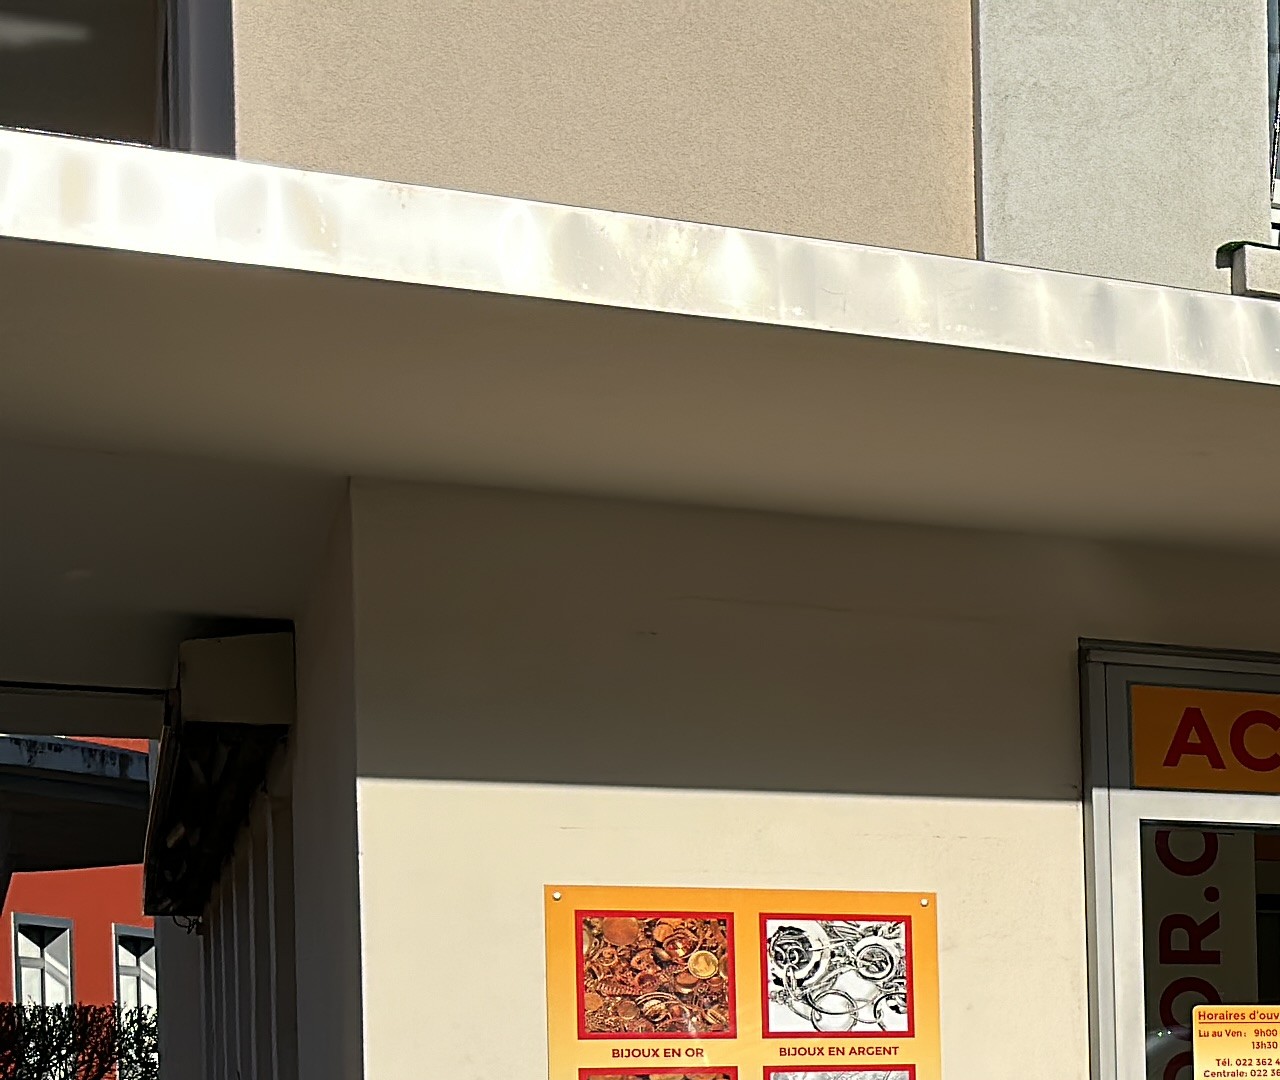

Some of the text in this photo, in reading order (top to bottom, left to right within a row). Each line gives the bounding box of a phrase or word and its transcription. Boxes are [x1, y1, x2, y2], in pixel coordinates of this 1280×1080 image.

[1198, 1010, 1245, 1020] Horaires
[1254, 1029, 1277, 1037] 9h00
[612, 1048, 704, 1058] BIJOUX EN OR
[780, 1047, 899, 1056] BIJOUX EN ARGENT
